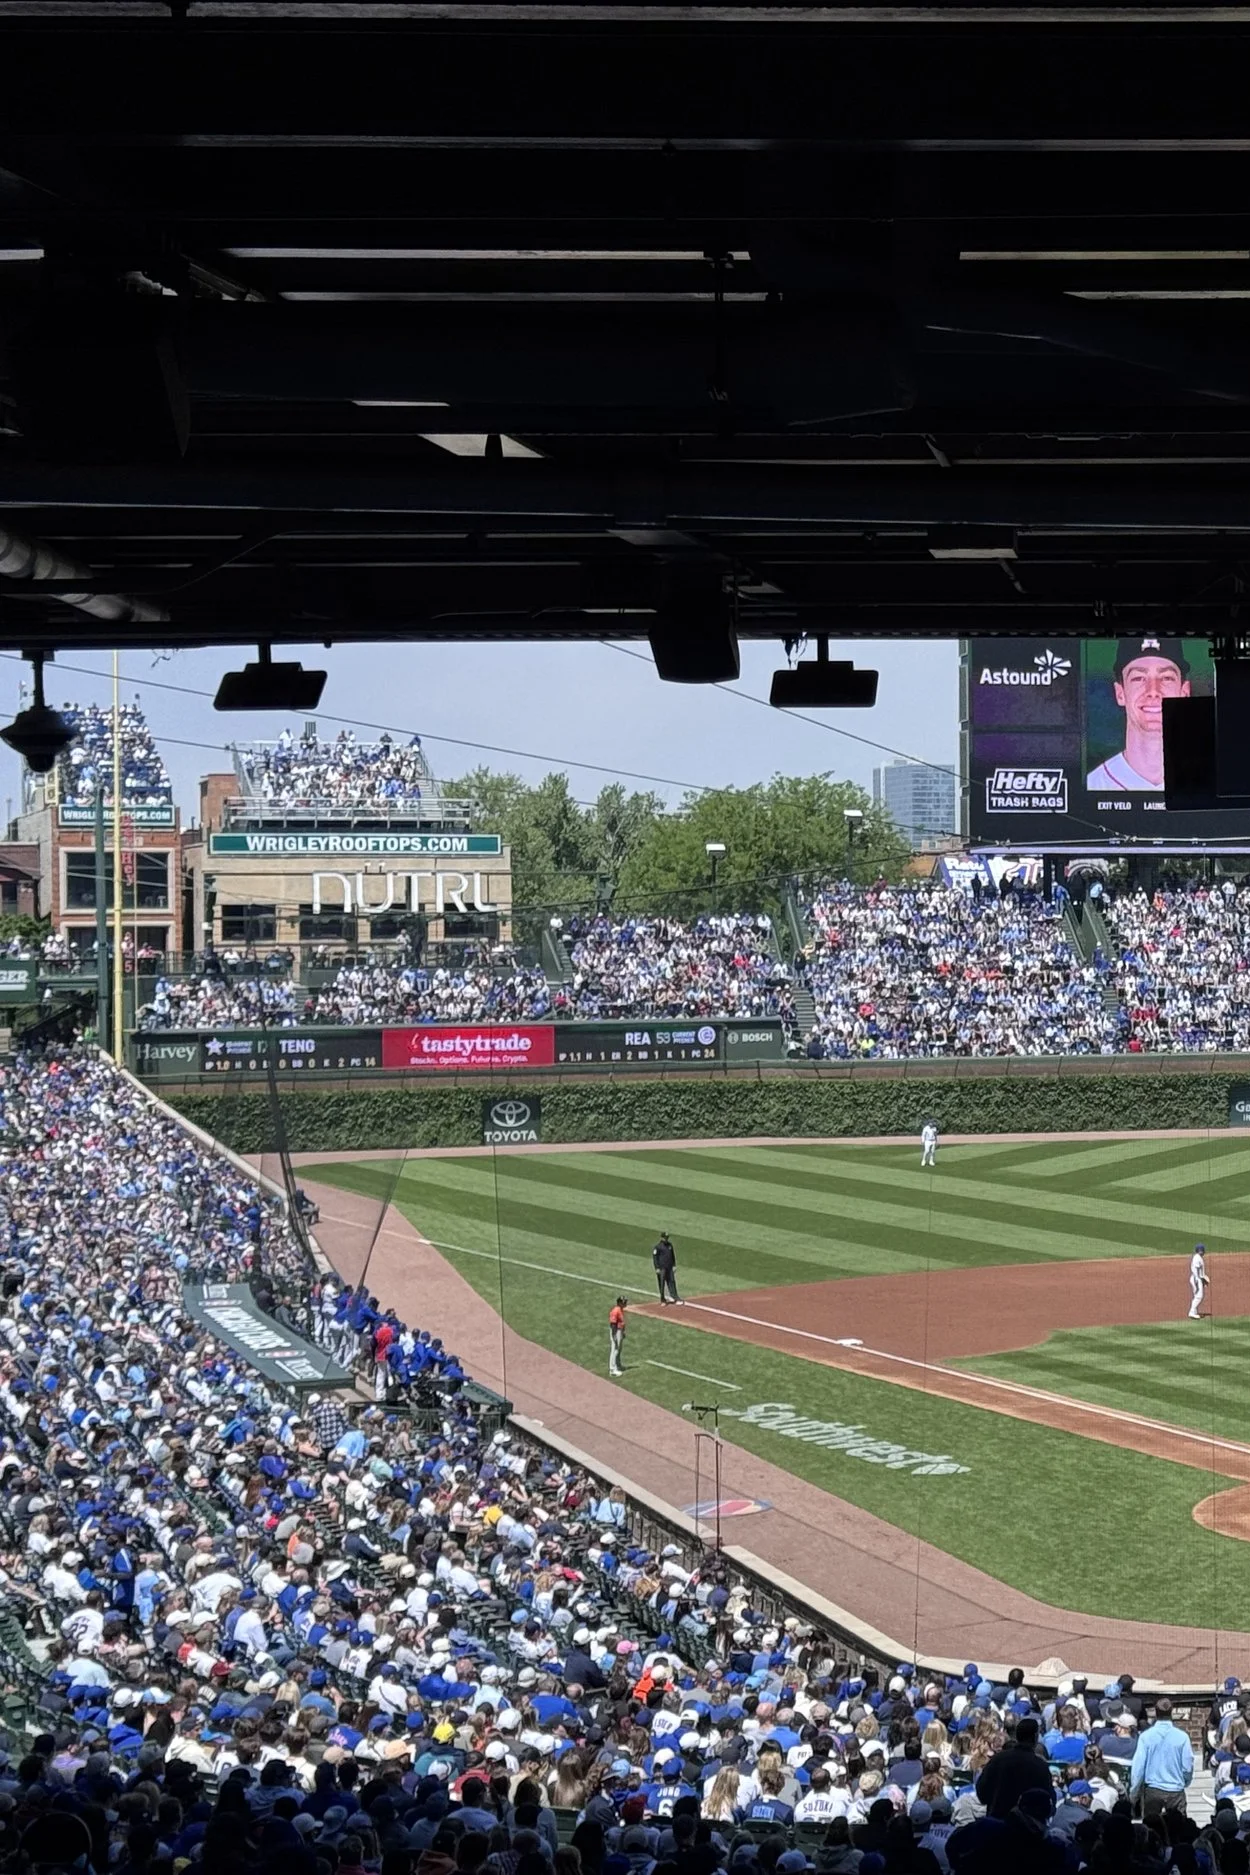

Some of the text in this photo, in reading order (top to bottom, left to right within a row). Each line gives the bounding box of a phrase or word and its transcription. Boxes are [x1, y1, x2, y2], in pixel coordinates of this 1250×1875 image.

[979, 668, 1051, 685] Astound
[996, 772, 1057, 793] Hefty
[991, 797, 1063, 807] TRASH BAGS
[1097, 802, 1131, 810] EXIT VELO
[247, 836, 468, 851] WRIGLEYROOFTOPS.COM
[625, 1032, 651, 1045] REA
[656, 1033, 670, 1044] 53
[742, 1032, 773, 1043] BOSCH
[279, 1039, 315, 1054] TENG
[421, 1034, 532, 1056] tastytrade
[136, 1043, 196, 1062] Harvey
[570, 1052, 581, 1062] 1.1
[626, 1051, 633, 1061] 2
[704, 1048, 715, 1059] 24
[338, 1058, 344, 1068] 2
[364, 1058, 376, 1067] 14
[484, 1129, 537, 1142] TOYOTA
[803, 1800, 833, 1813] SUZUKI
